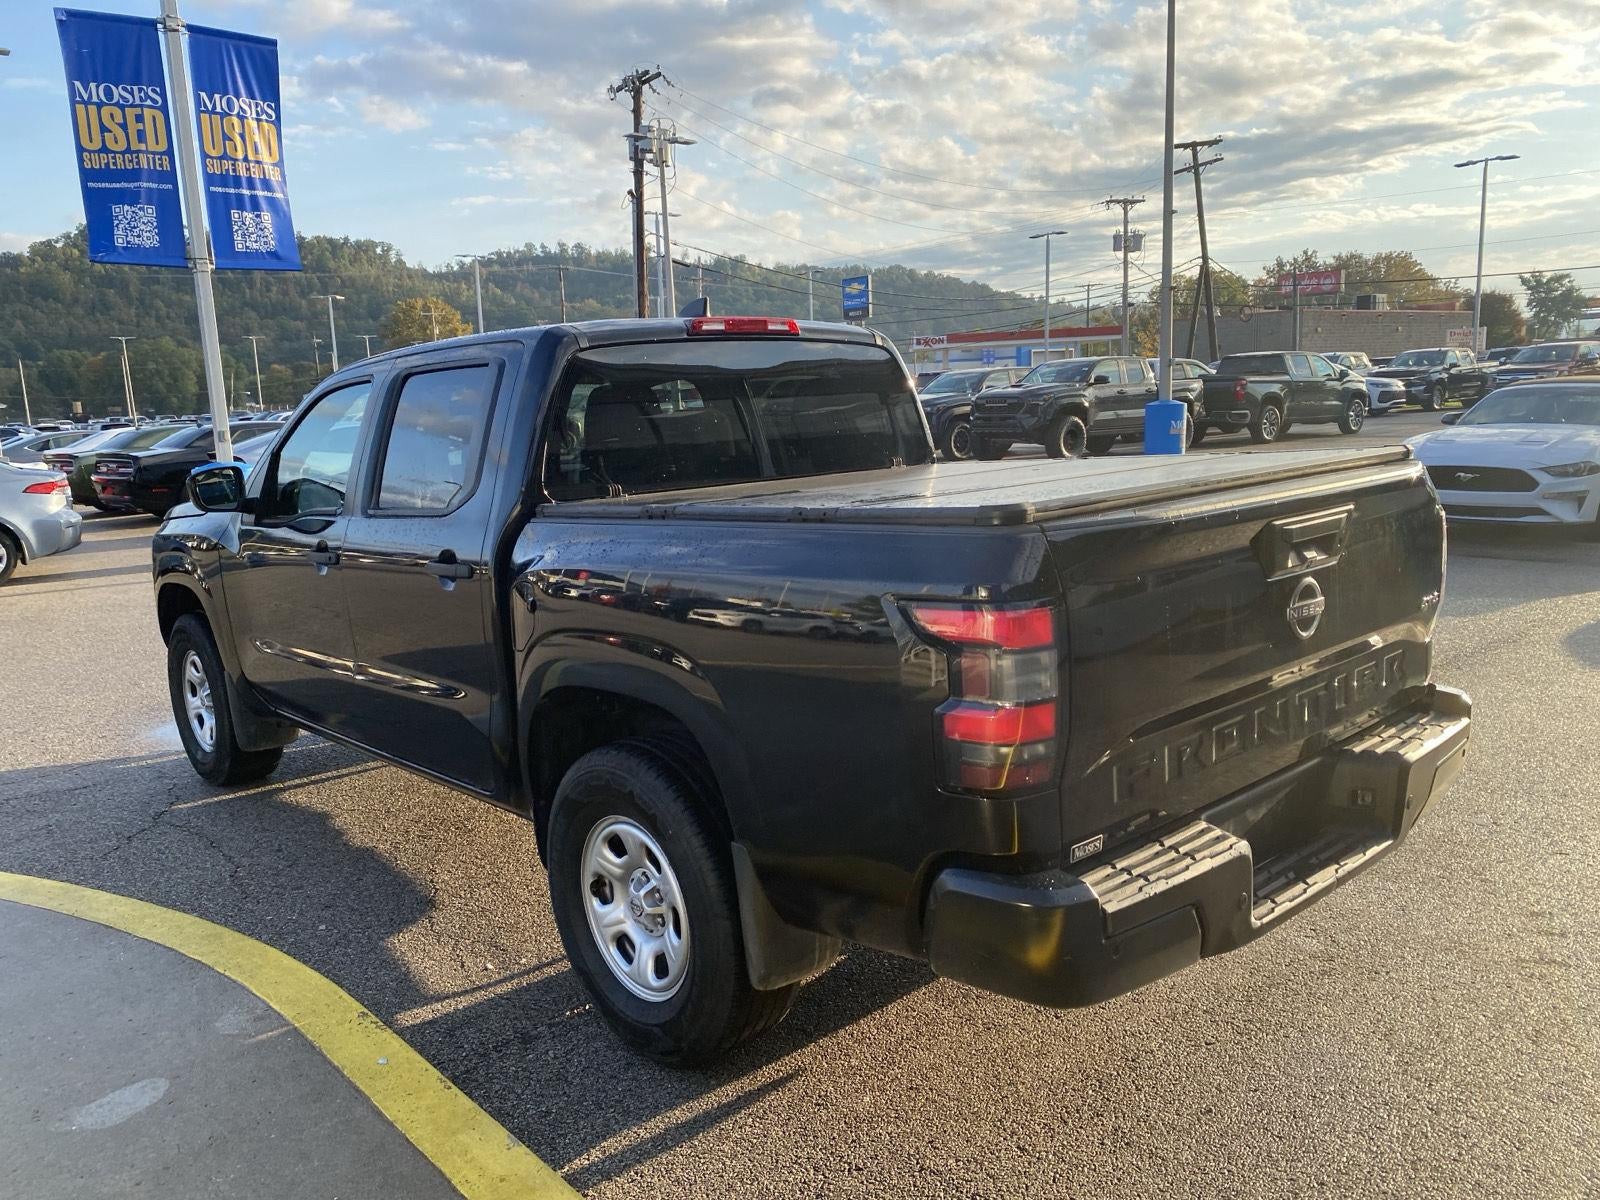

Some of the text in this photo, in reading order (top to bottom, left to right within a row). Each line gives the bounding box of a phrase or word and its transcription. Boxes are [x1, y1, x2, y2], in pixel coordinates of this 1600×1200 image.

[72, 80, 162, 107] MOSES
[198, 91, 276, 121] MOSES
[75, 103, 168, 152] USED
[200, 112, 280, 164] USED
[82, 151, 171, 171] SUPERCENTER
[205, 158, 282, 182] SUPERCENTER
[87, 181, 173, 190] mosesusedsupercenter.com
[1281, 274, 1318, 293] Wndy's
[915, 336, 945, 347] EXXON
[1112, 648, 1406, 804] FRONTIER
[1073, 840, 1101, 860] MOSES
